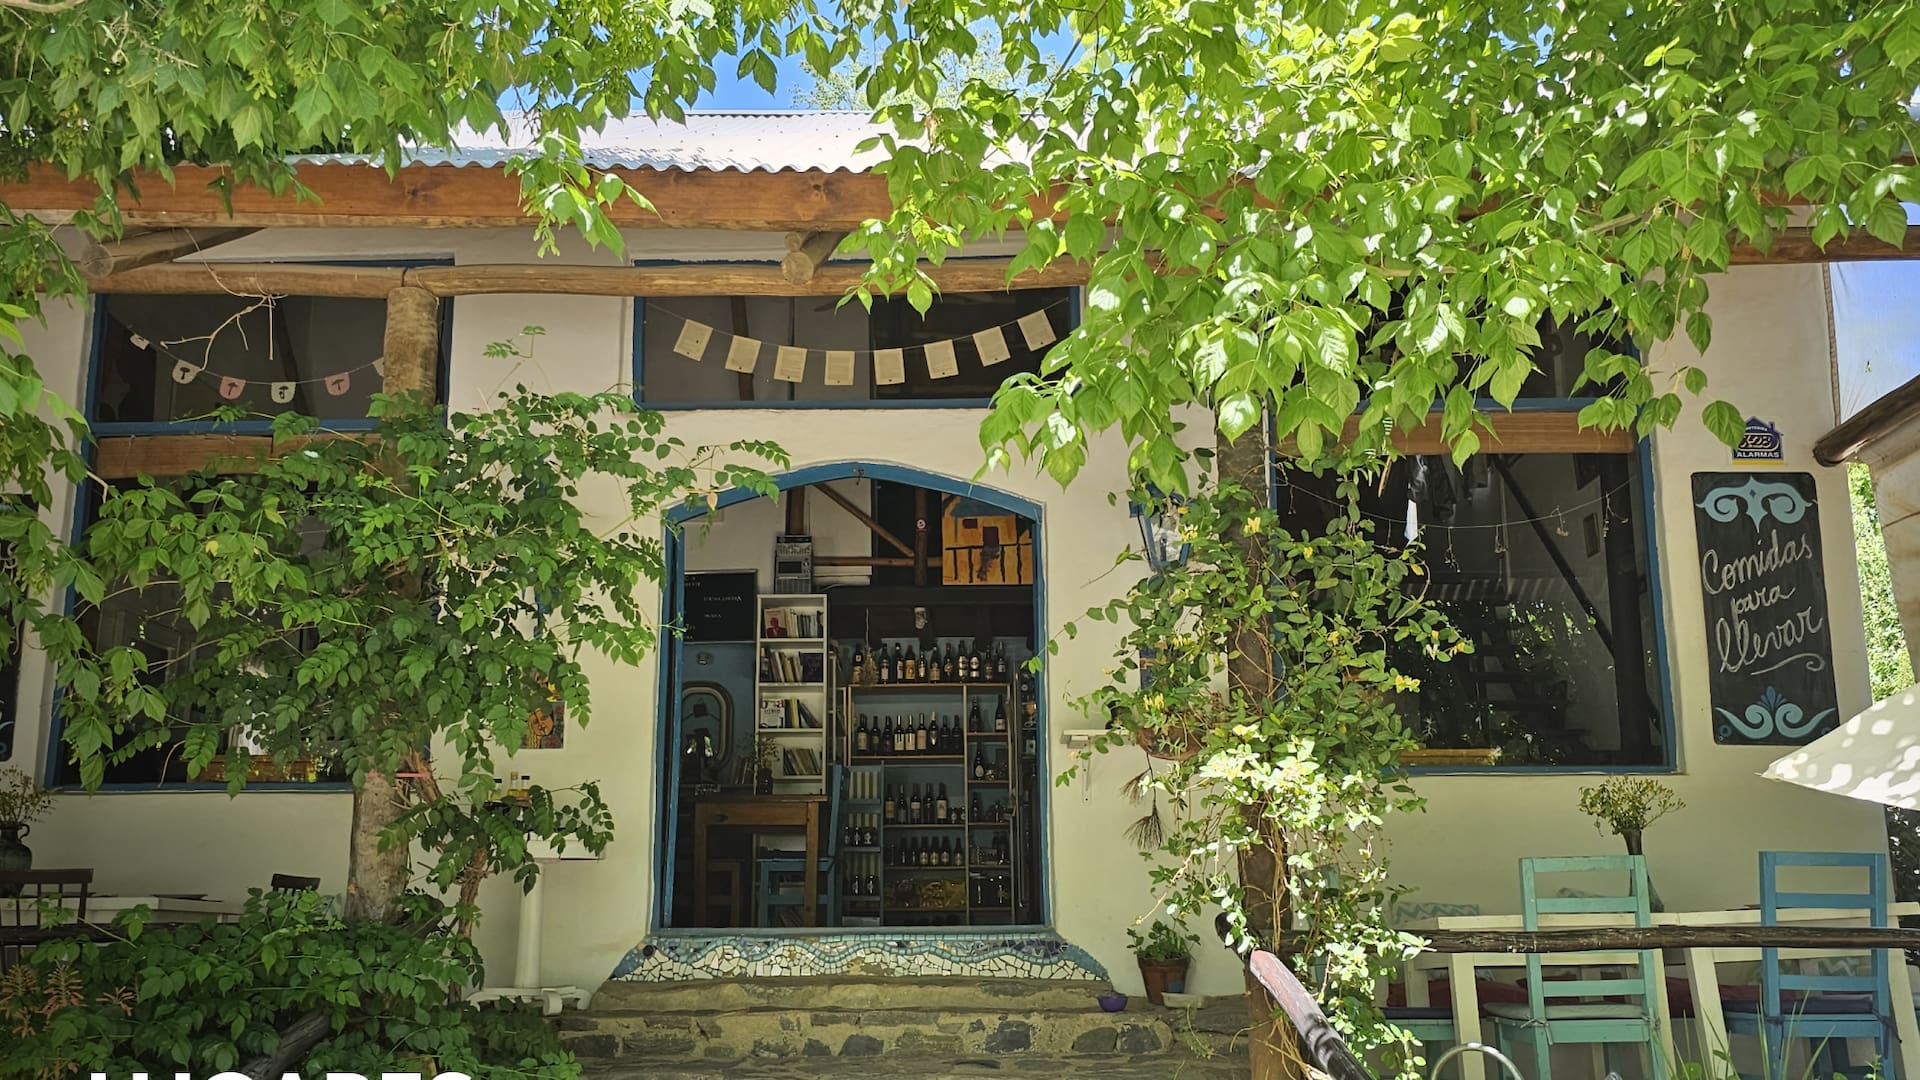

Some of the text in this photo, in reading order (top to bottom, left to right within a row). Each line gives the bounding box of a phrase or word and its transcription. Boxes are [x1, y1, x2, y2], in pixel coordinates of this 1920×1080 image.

[1702, 529, 1813, 595] Comidas
[1716, 606, 1823, 673] llevar
[1730, 585, 1796, 630] para
